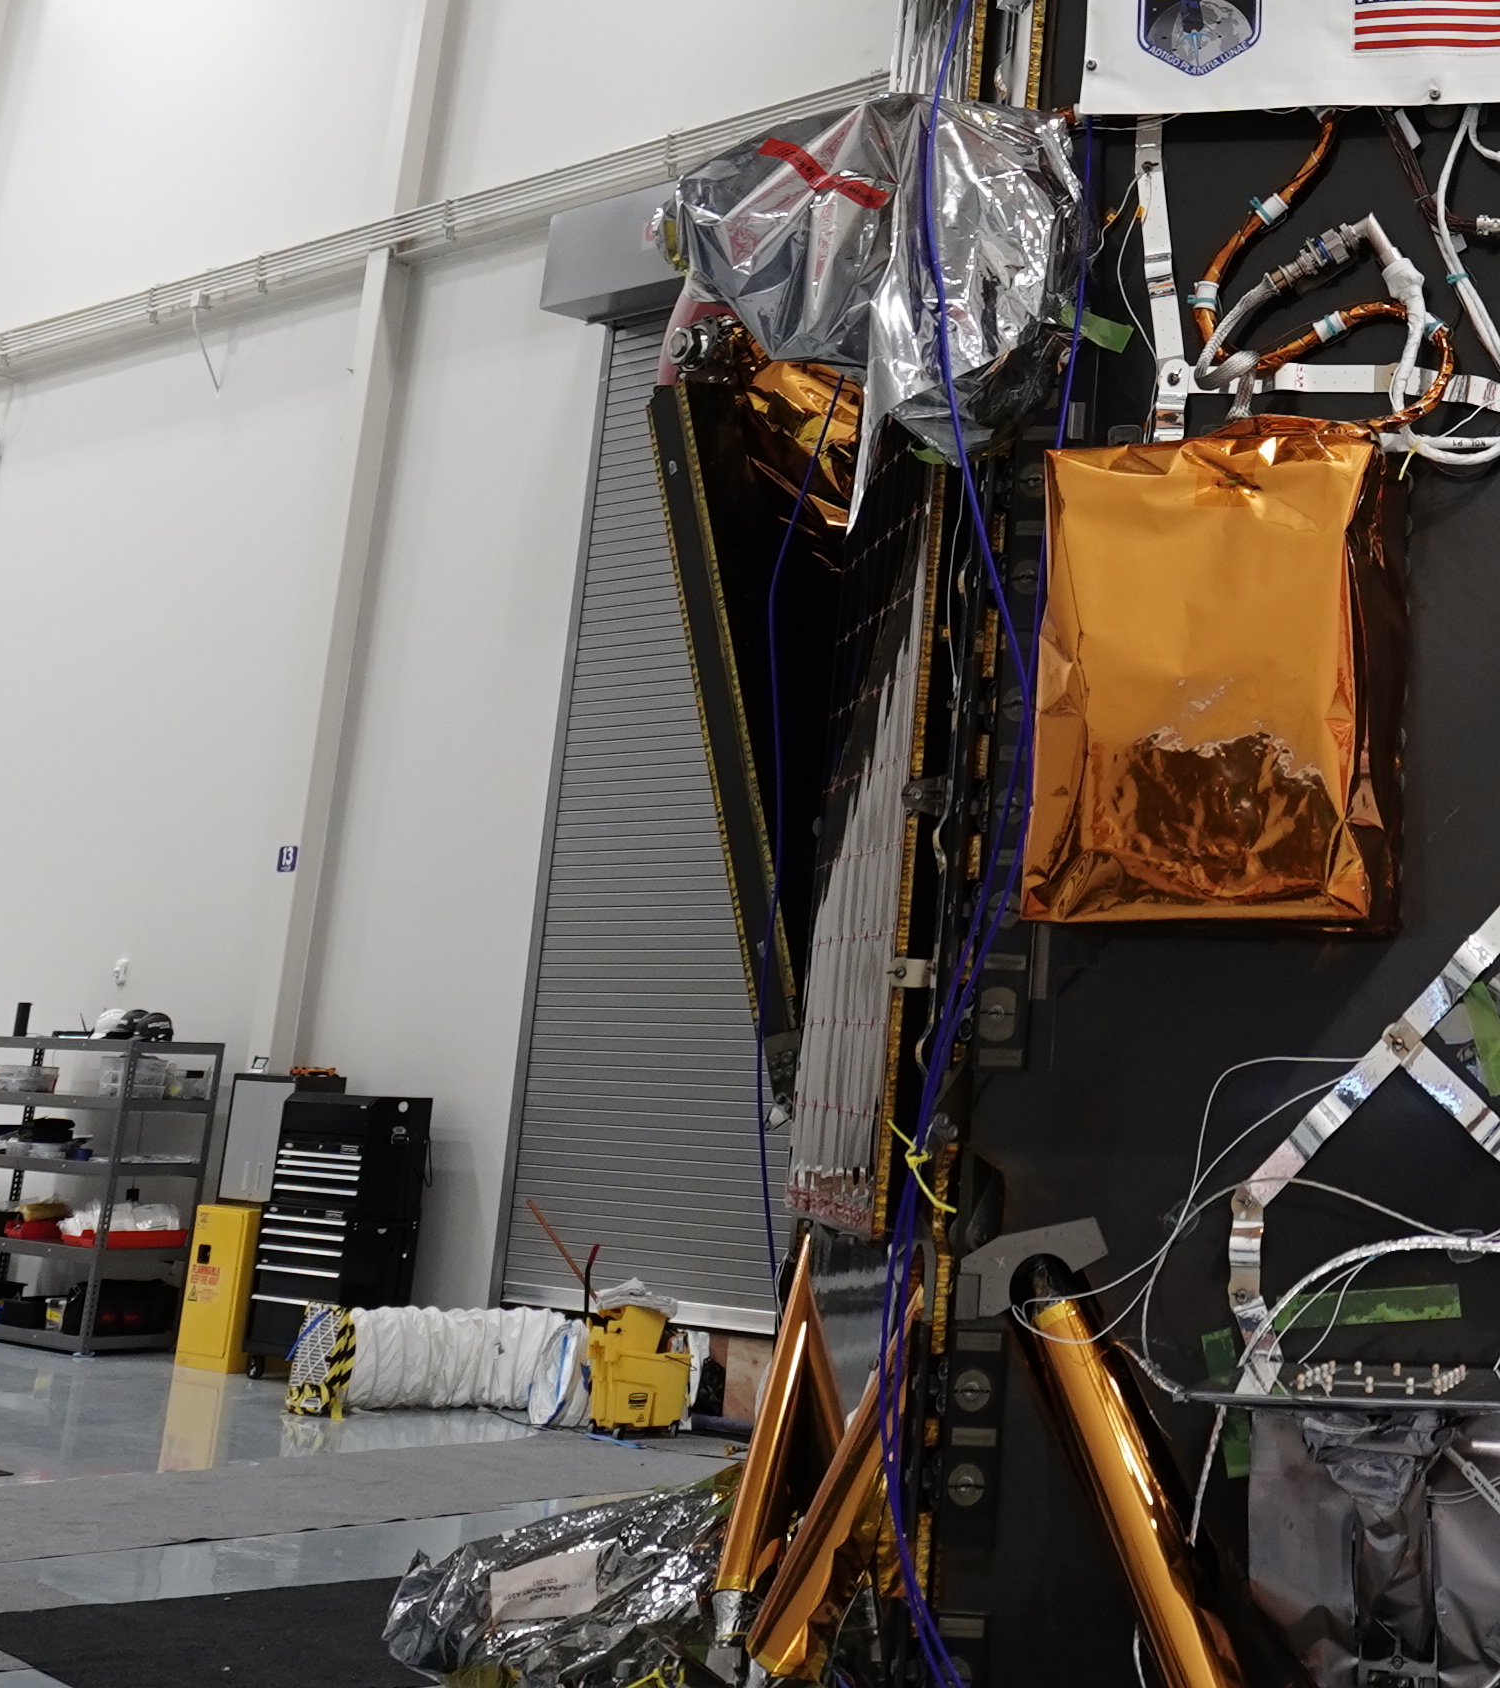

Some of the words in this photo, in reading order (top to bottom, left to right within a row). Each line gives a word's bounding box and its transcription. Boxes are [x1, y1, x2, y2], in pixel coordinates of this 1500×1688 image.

[1148, 45, 1181, 67] ADTIGO
[1179, 59, 1221, 76] PLANITIA
[1220, 41, 1250, 63] LUNAE
[281, 845, 295, 866] 13
[501, 1591, 522, 1601] ASSY
